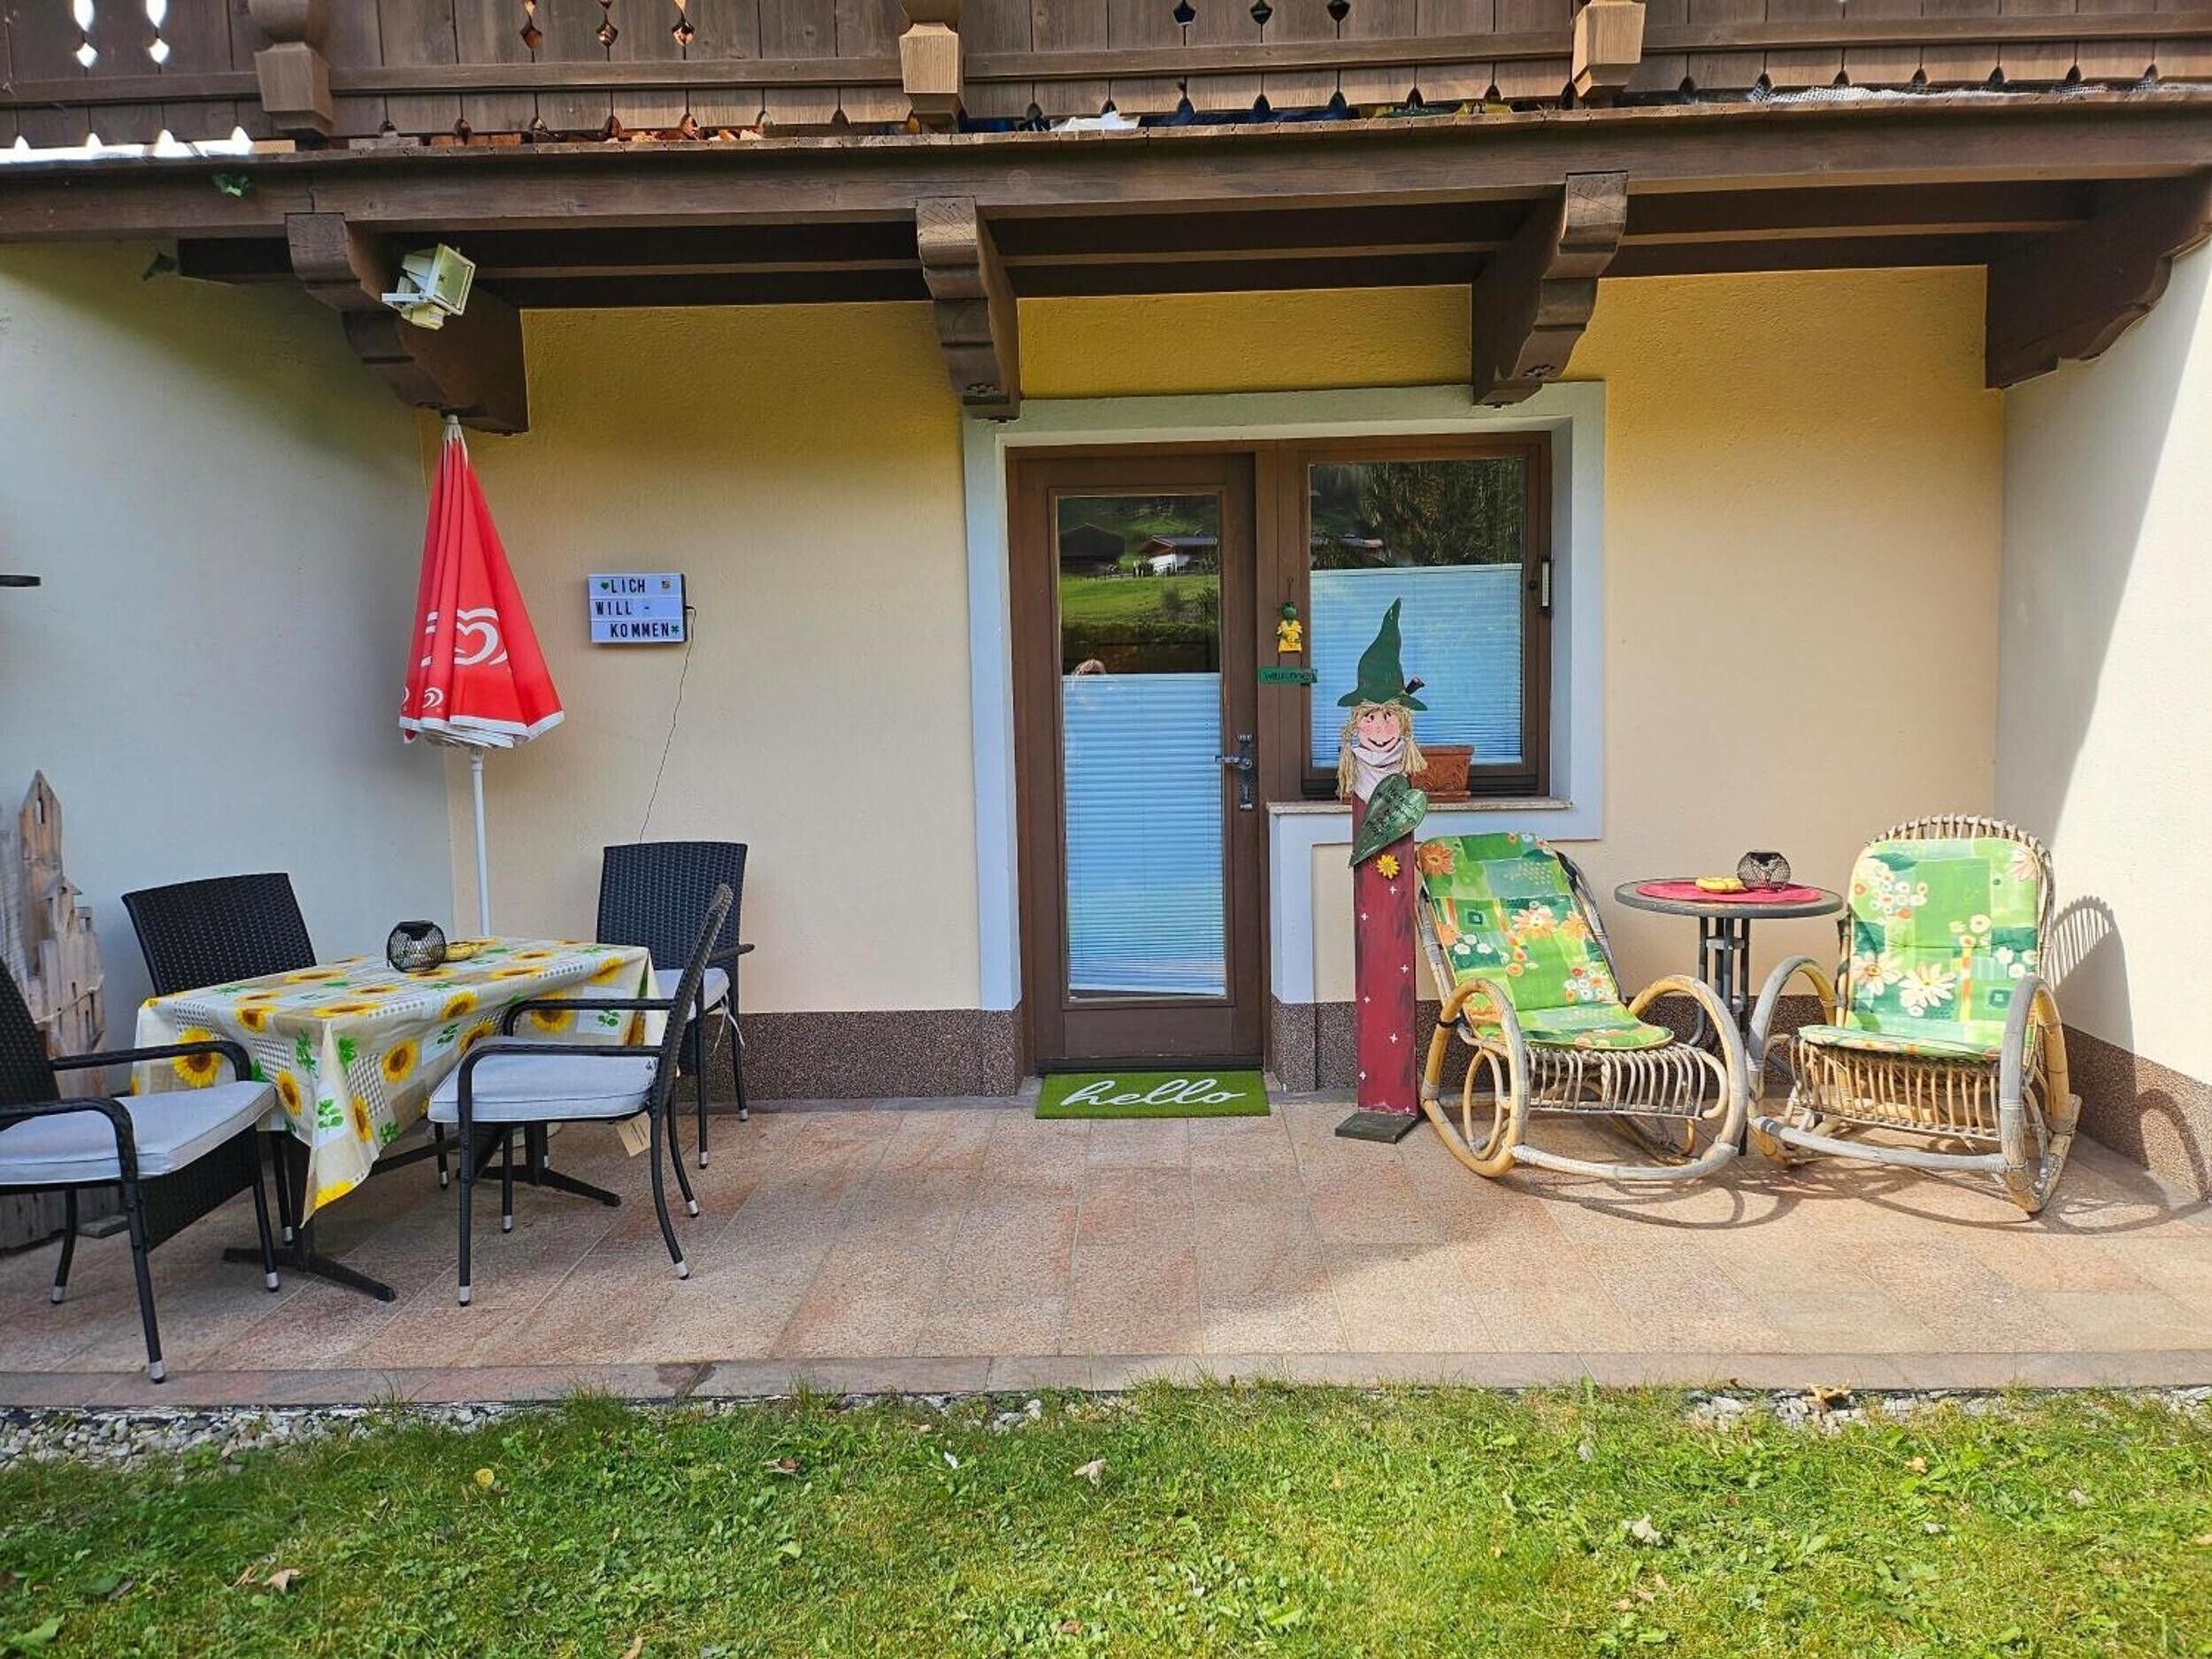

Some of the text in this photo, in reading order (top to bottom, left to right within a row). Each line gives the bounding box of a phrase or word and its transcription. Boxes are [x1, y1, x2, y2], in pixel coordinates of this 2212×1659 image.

[610, 578, 646, 594] LICH
[595, 601, 632, 616] WILL
[610, 622, 670, 638] KOMMEN
[1061, 1079, 1247, 1106] hello
